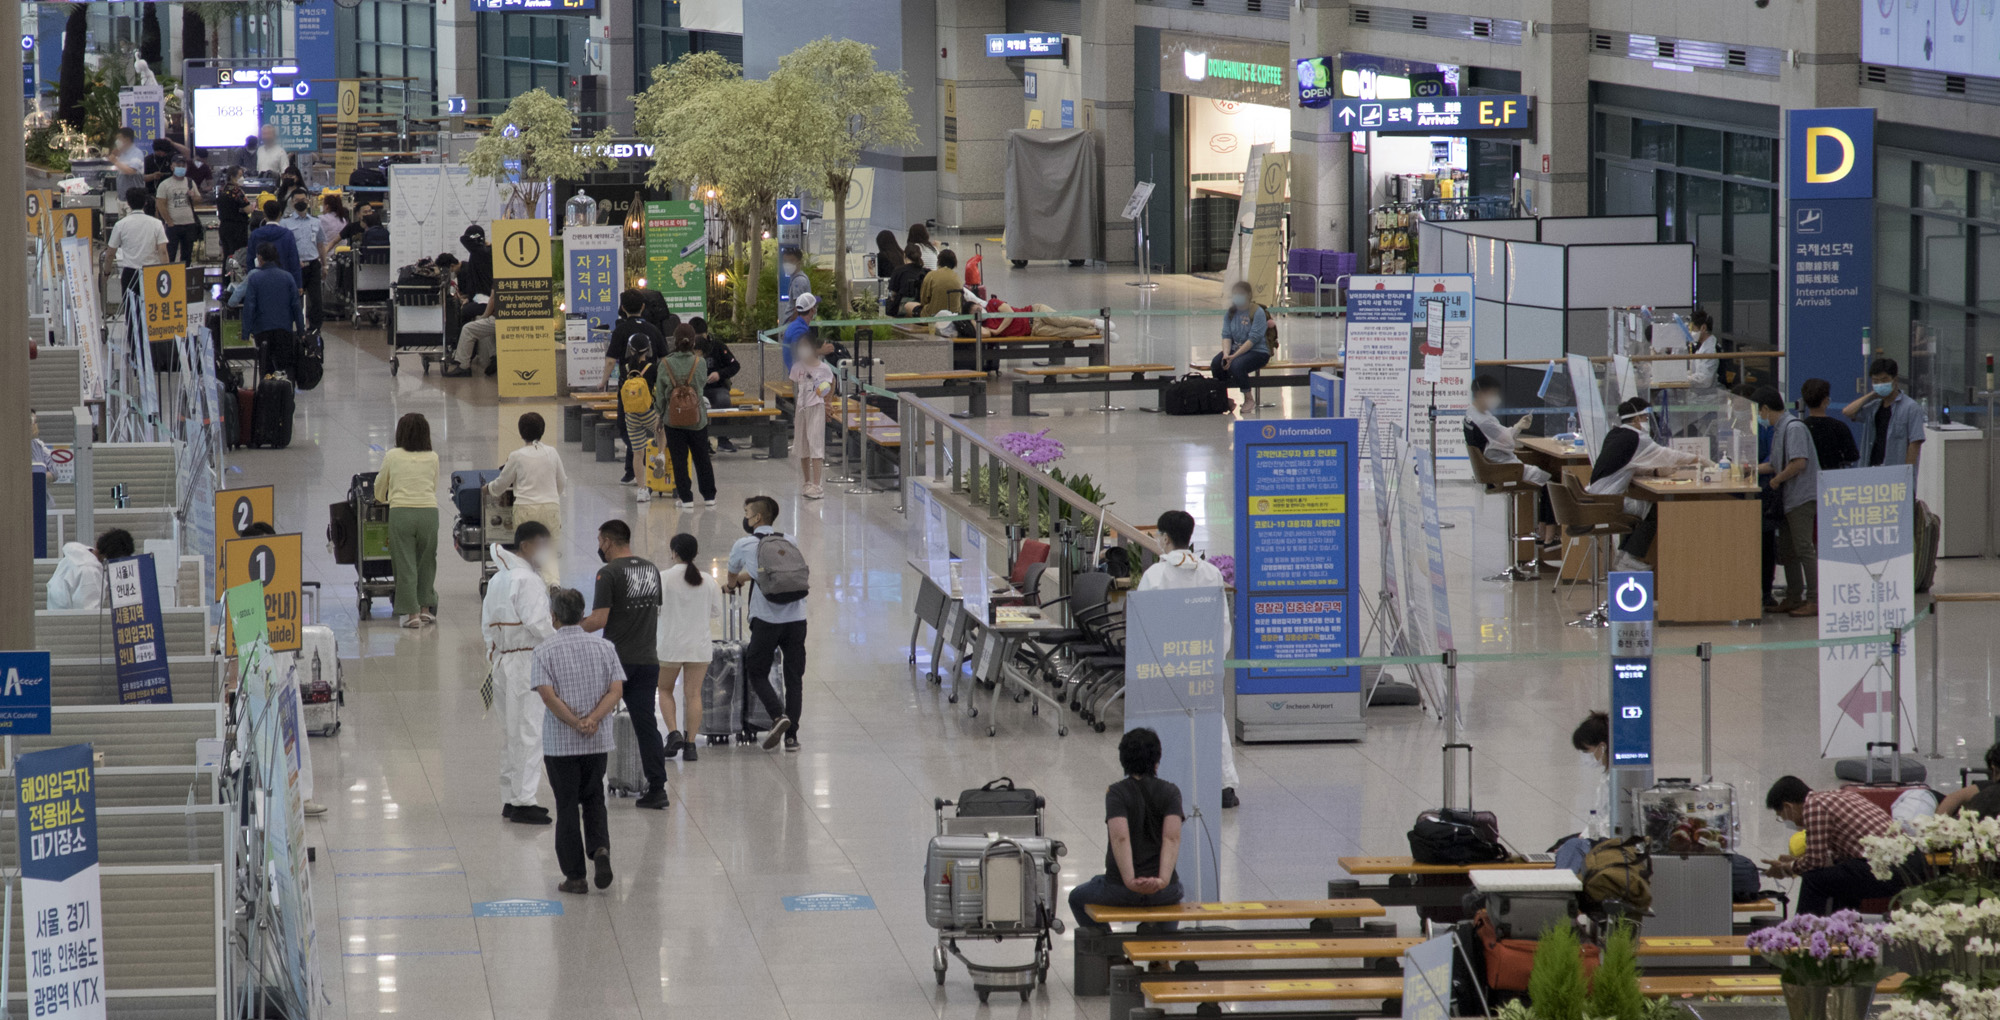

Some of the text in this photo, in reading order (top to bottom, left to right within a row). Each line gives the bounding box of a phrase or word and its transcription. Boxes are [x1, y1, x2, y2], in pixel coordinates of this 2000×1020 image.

[1208, 58, 1248, 81] DOUGHNUTS
[1257, 65, 1282, 85] COFFEE
[1302, 88, 1331, 99] OPEN
[1418, 84, 1438, 94] CU
[275, 103, 307, 114] 자가용
[1388, 108, 1412, 122] 도착
[1479, 101, 1517, 126] E,F
[270, 115, 312, 125] 이용고객
[1418, 115, 1459, 126] Arrivals
[634, 143, 655, 157] TV
[1806, 127, 1855, 183] D
[28, 197, 37, 215] 5
[614, 201, 629, 211] LG
[66, 216, 76, 236] 4
[1797, 243, 1853, 256] 국제선도착
[159, 273, 169, 295] 3
[498, 280, 549, 289] 음식물 취식불가
[1796, 287, 1858, 296] International
[515, 294, 549, 302] beverages
[1796, 298, 1831, 306] Arrivals
[148, 301, 183, 323] 강원도
[498, 309, 510, 317] (No
[527, 309, 551, 317] please)
[147, 323, 185, 339] Gangwon-do
[1279, 427, 1332, 436] Information
[1256, 450, 1301, 458] 고객안내근무자
[238, 502, 248, 531] 2
[1255, 521, 1285, 529] 코로나-19
[115, 564, 134, 580] 서울시
[256, 552, 265, 581] 1
[117, 583, 136, 598] 안내소
[115, 604, 144, 625] 서울지역
[1255, 600, 1342, 614] 경찰관 집중순찰구역
[117, 623, 154, 645] 해외입국자
[1617, 629, 1650, 638] CHARGE
[119, 647, 135, 666] 안내
[13, 711, 38, 719] Counter
[21, 768, 90, 803] 해외입국자
[29, 798, 85, 832] 전용버스
[30, 827, 87, 861] 대기장소
[66, 900, 90, 933] 경기
[57, 938, 98, 973] 인천송도
[34, 976, 99, 1017] 광명역 KTX
